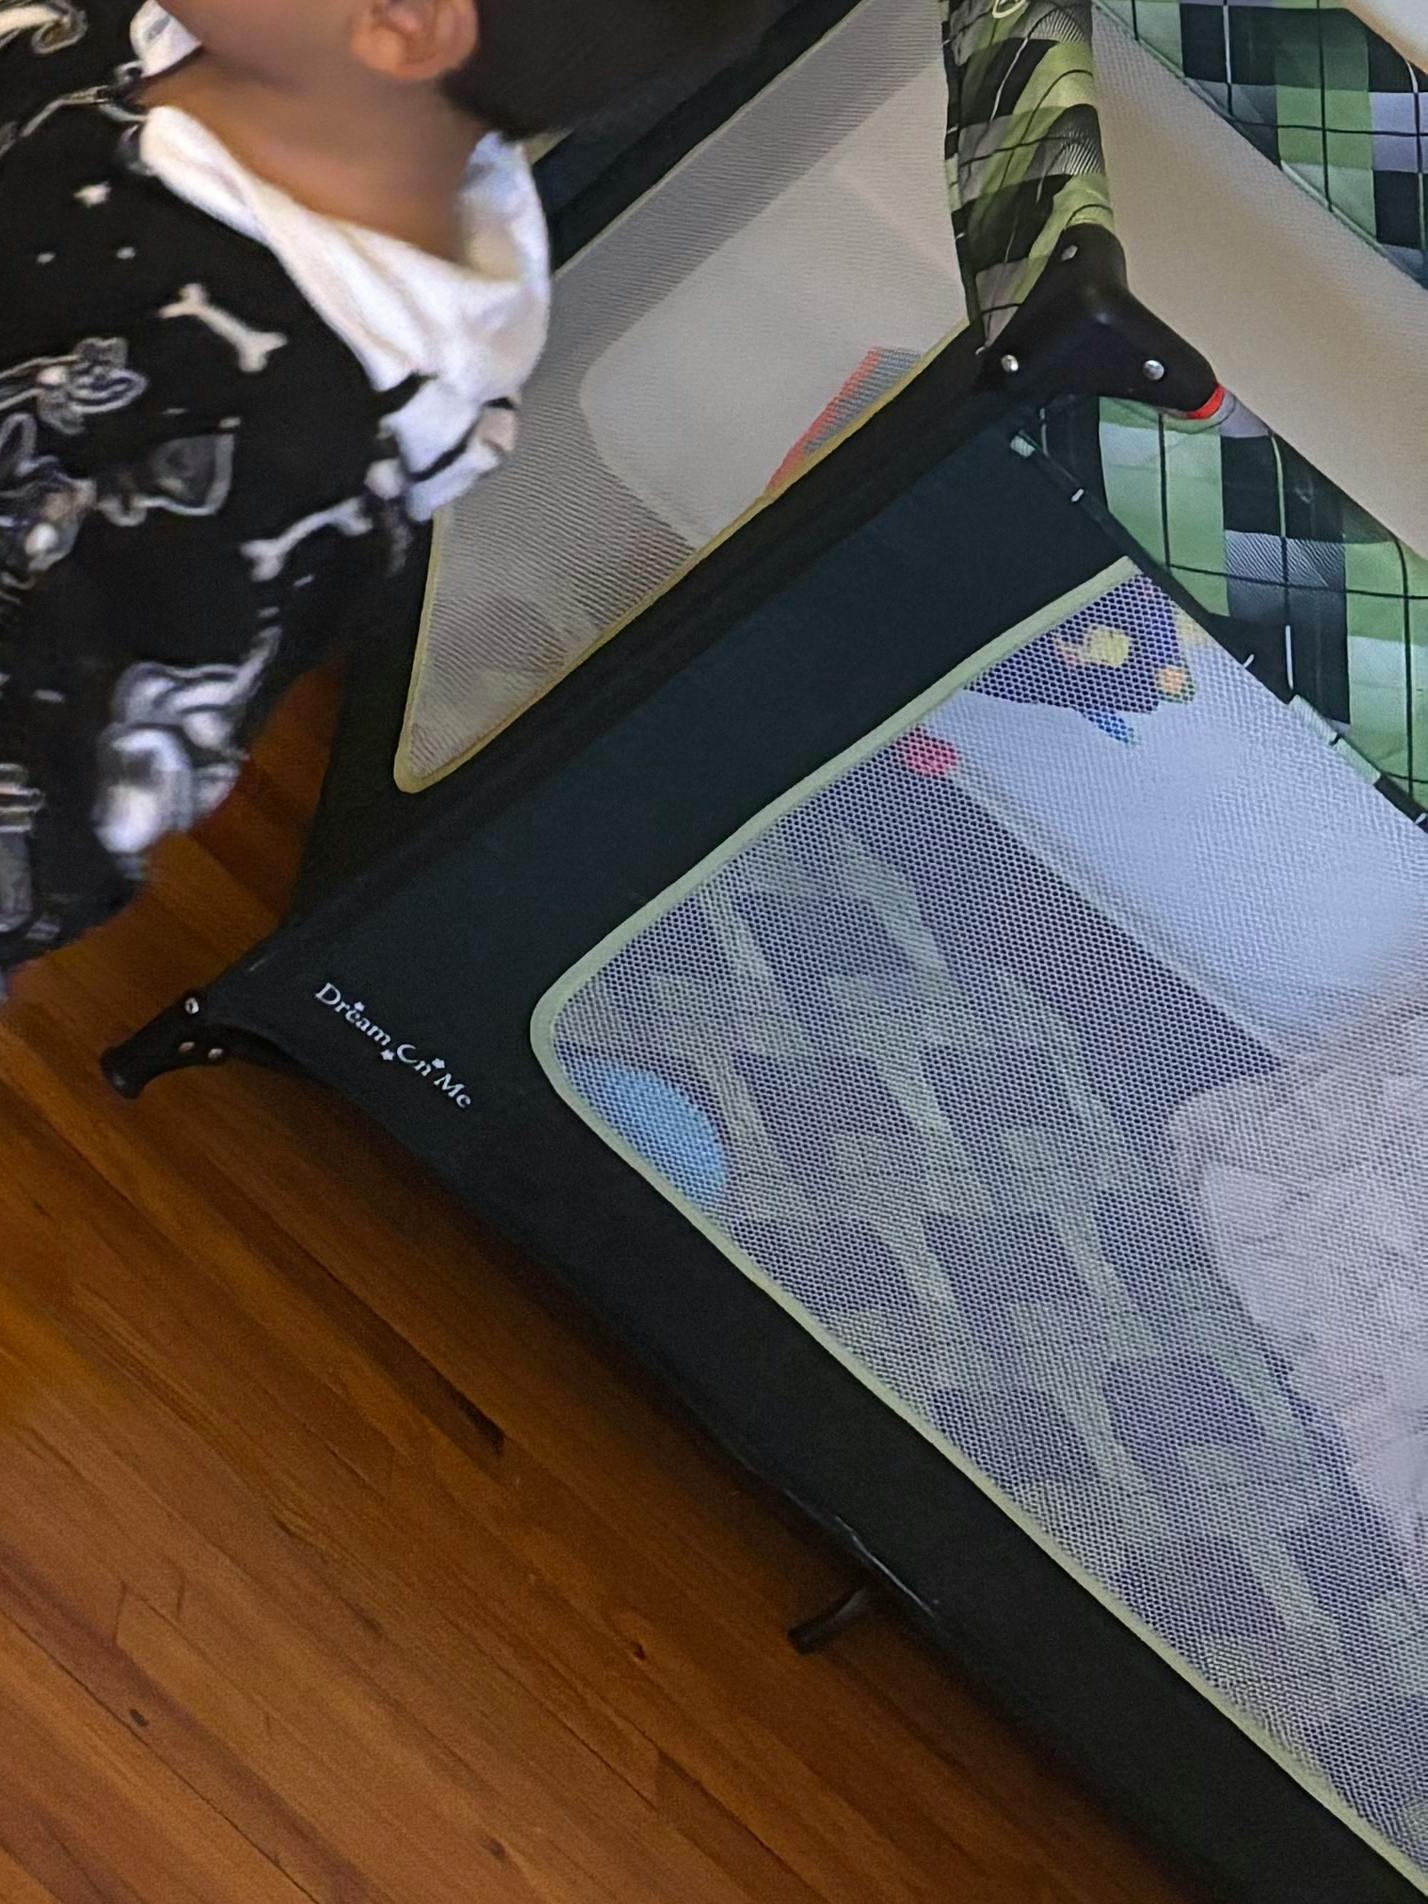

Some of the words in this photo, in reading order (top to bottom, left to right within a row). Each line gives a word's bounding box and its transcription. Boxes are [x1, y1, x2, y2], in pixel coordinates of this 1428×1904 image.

[316, 983, 391, 1046] Dream
[396, 1045, 431, 1076] On
[434, 1074, 471, 1107] Me
